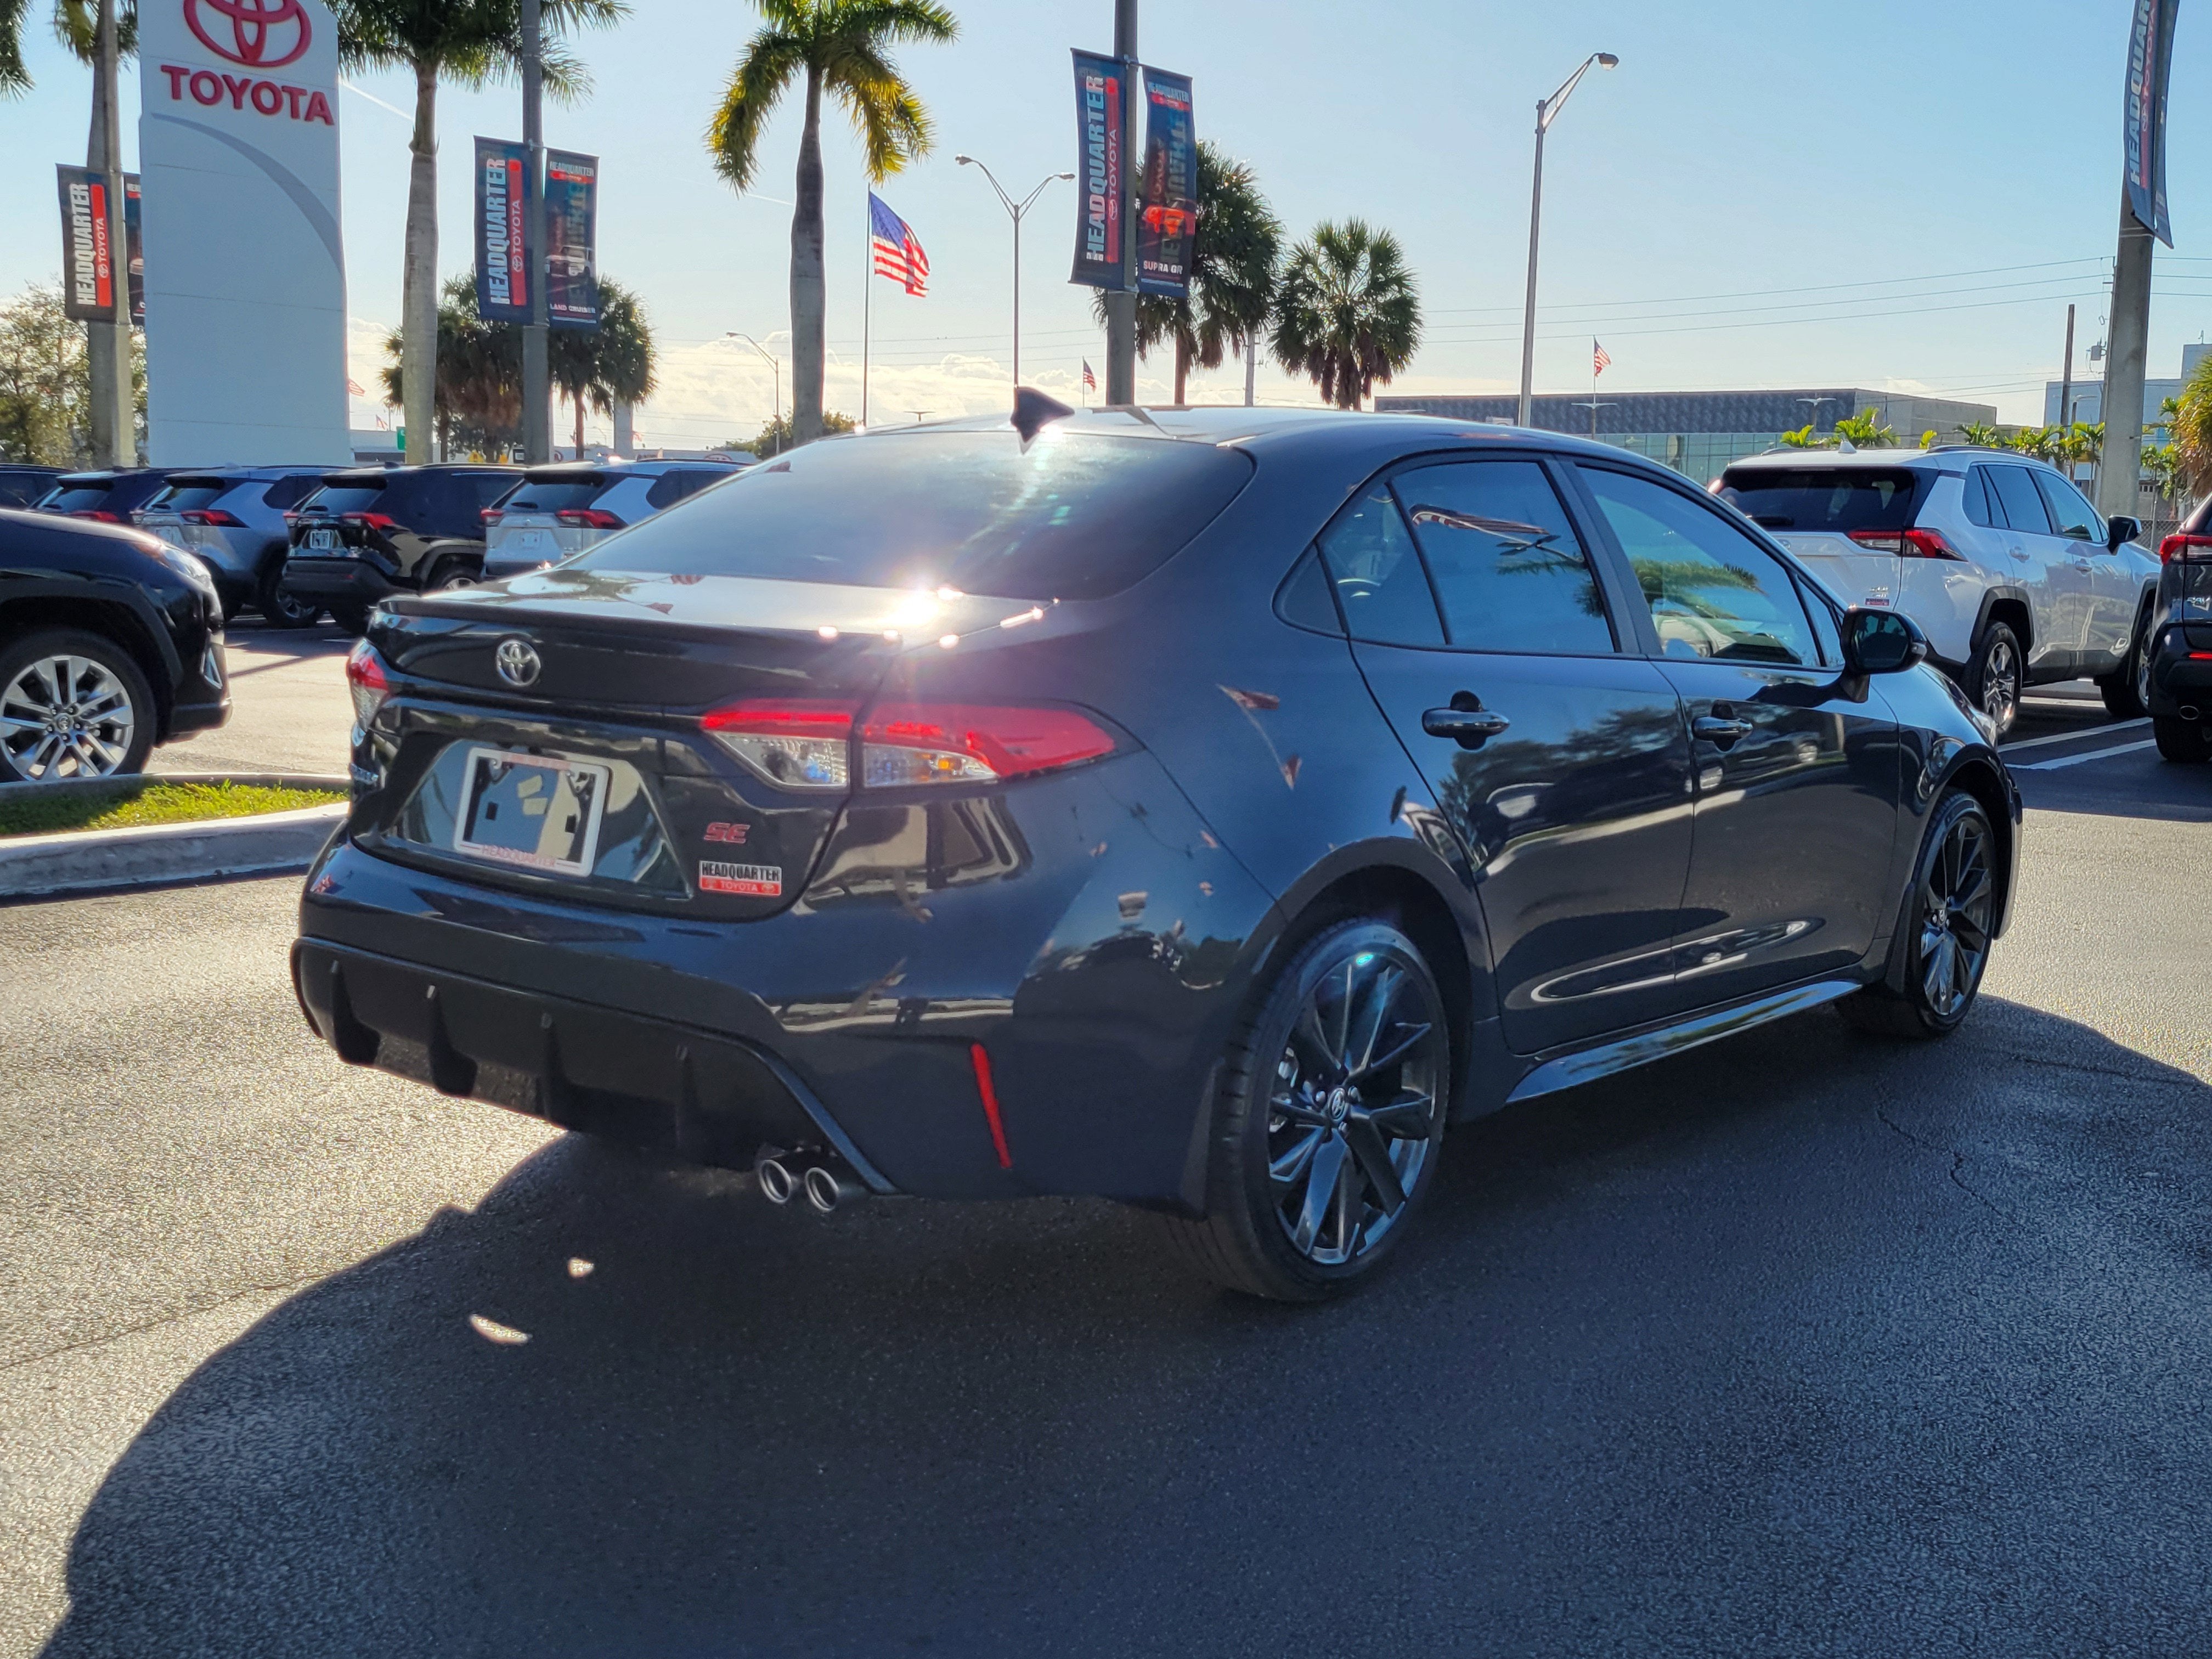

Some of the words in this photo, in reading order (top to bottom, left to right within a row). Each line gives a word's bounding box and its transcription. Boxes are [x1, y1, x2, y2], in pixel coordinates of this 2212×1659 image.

[161, 65, 335, 126] TOYOTA
[1085, 75, 1105, 262] HEADQUARTER
[1109, 129, 1118, 198] TOYOTA
[69, 183, 97, 306] HEADQUARTER
[96, 218, 106, 262] TOYOTA
[486, 158, 511, 305] HEADQUARTER
[512, 200, 522, 254] TOYOTA
[1143, 260, 1169, 273] SUPRA
[1170, 264, 1183, 275] GR
[550, 303, 567, 311] LAND
[703, 822, 751, 844] SE
[702, 862, 780, 882] HEADQUARTER
[720, 880, 758, 891] TOYOTA
